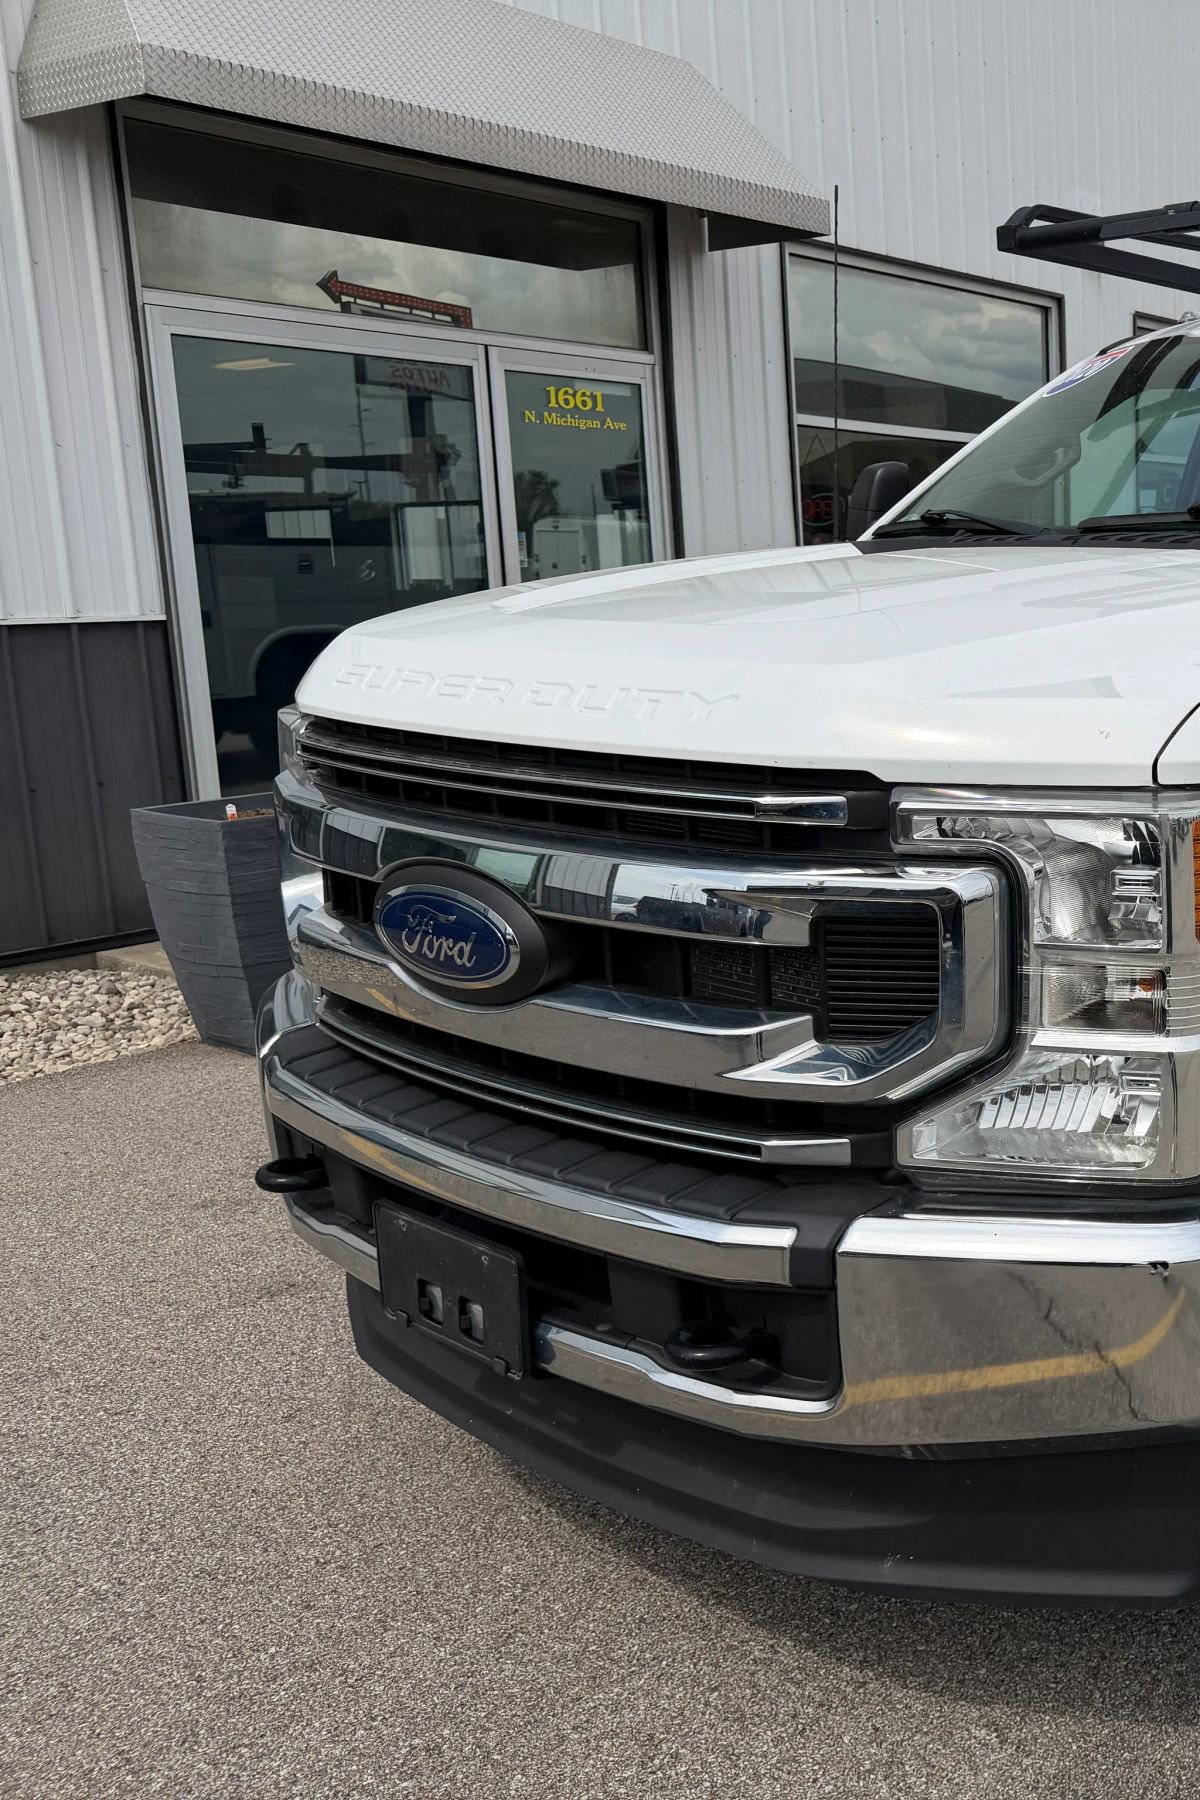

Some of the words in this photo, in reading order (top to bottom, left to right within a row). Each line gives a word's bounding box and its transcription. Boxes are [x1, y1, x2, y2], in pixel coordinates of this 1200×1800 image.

[545, 385, 605, 412] 1661
[524, 410, 540, 424] N.
[543, 411, 601, 430] Michigan
[603, 417, 628, 431] Ave
[803, 498, 833, 519] OPE
[333, 663, 514, 707] SUPER
[518, 680, 740, 722] DUTY
[401, 904, 478, 968] Ford
